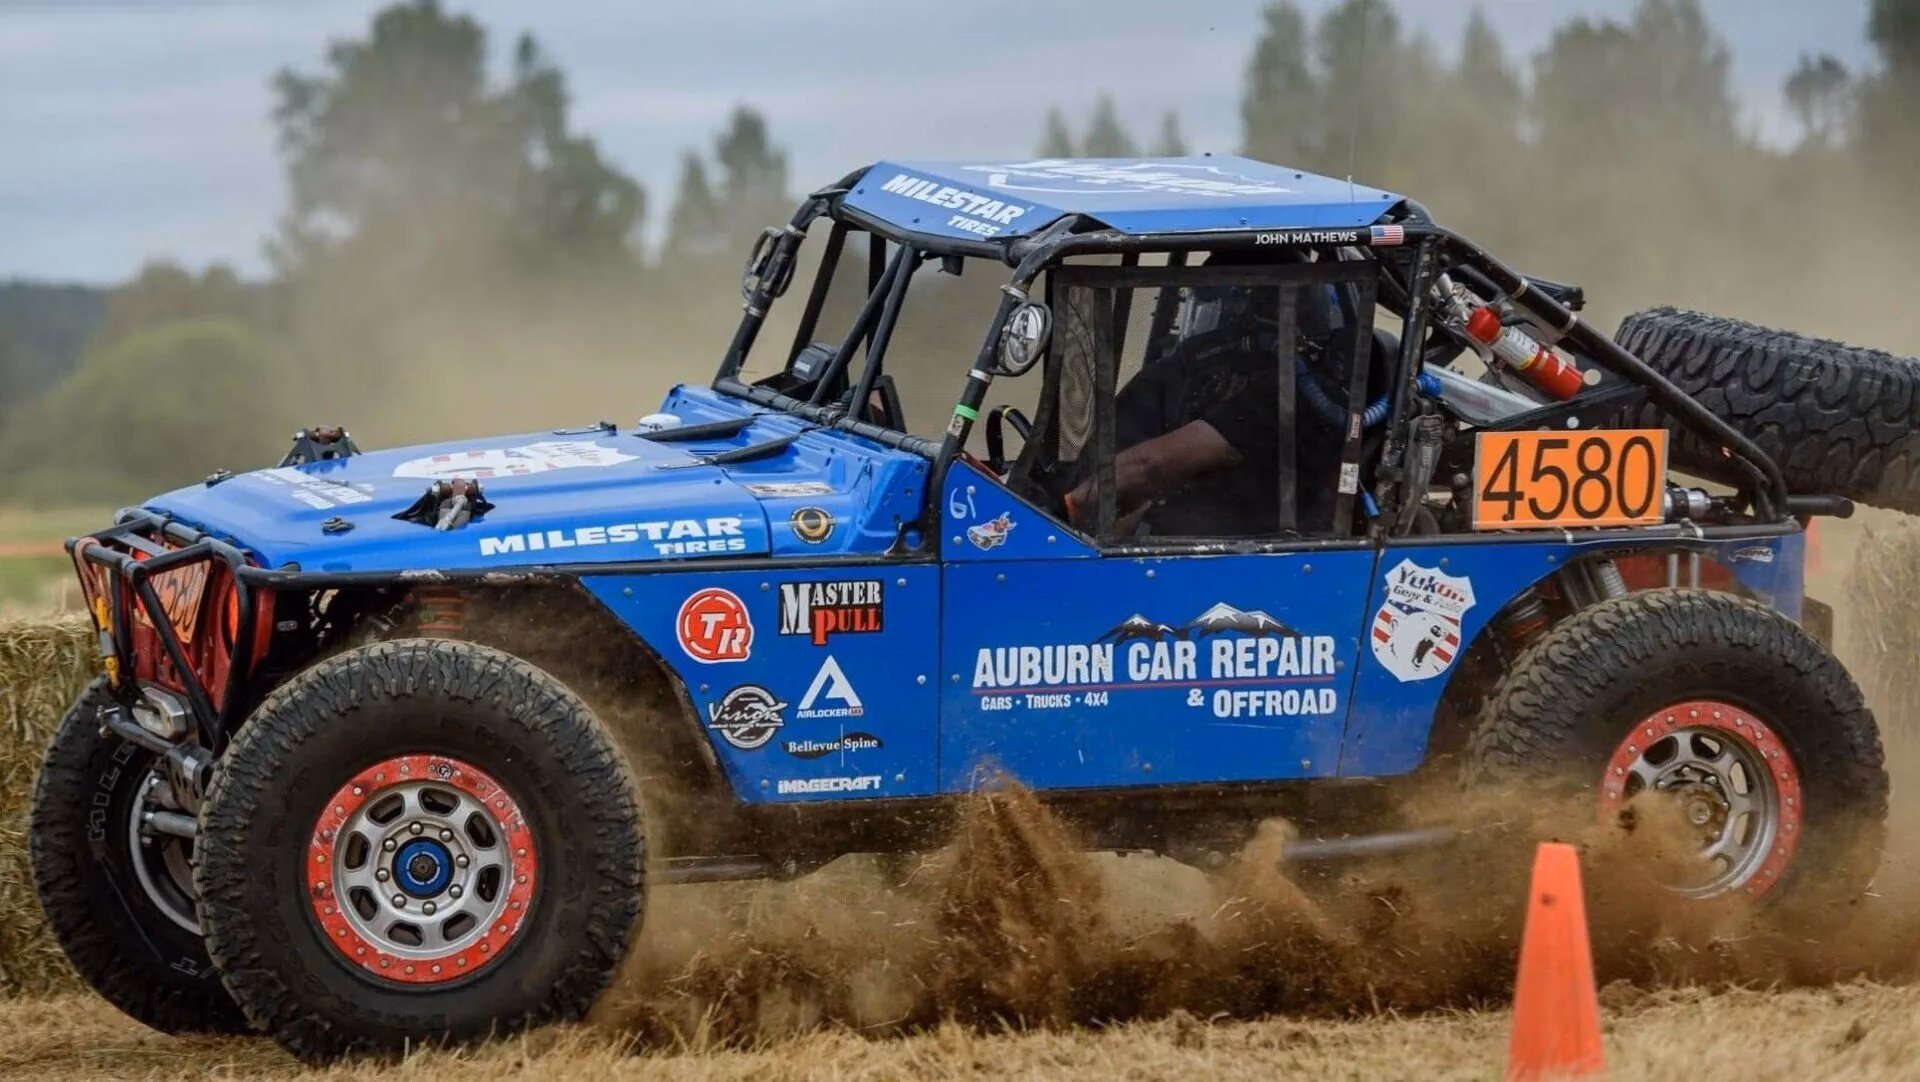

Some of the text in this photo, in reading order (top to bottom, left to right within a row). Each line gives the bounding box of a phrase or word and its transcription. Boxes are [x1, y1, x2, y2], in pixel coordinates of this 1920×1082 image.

[881, 174, 1025, 224] MILESTAR
[948, 215, 1000, 236] TIRES
[1254, 231, 1358, 245] JOHN MATHEWS
[1482, 436, 1656, 521] 4580
[479, 517, 743, 556] MILESTAR
[654, 538, 746, 556] TIRES
[780, 581, 881, 634] MASTER
[814, 607, 881, 645] PULL
[973, 635, 1336, 688] AUBURN CAR REPAIR
[797, 707, 848, 719] AIRLOCKER
[981, 696, 1012, 711] CARS
[1026, 692, 1071, 709] TRUCKS
[1187, 688, 1337, 718] & OFFROAD
[788, 737, 879, 753] Bellevue Spine
